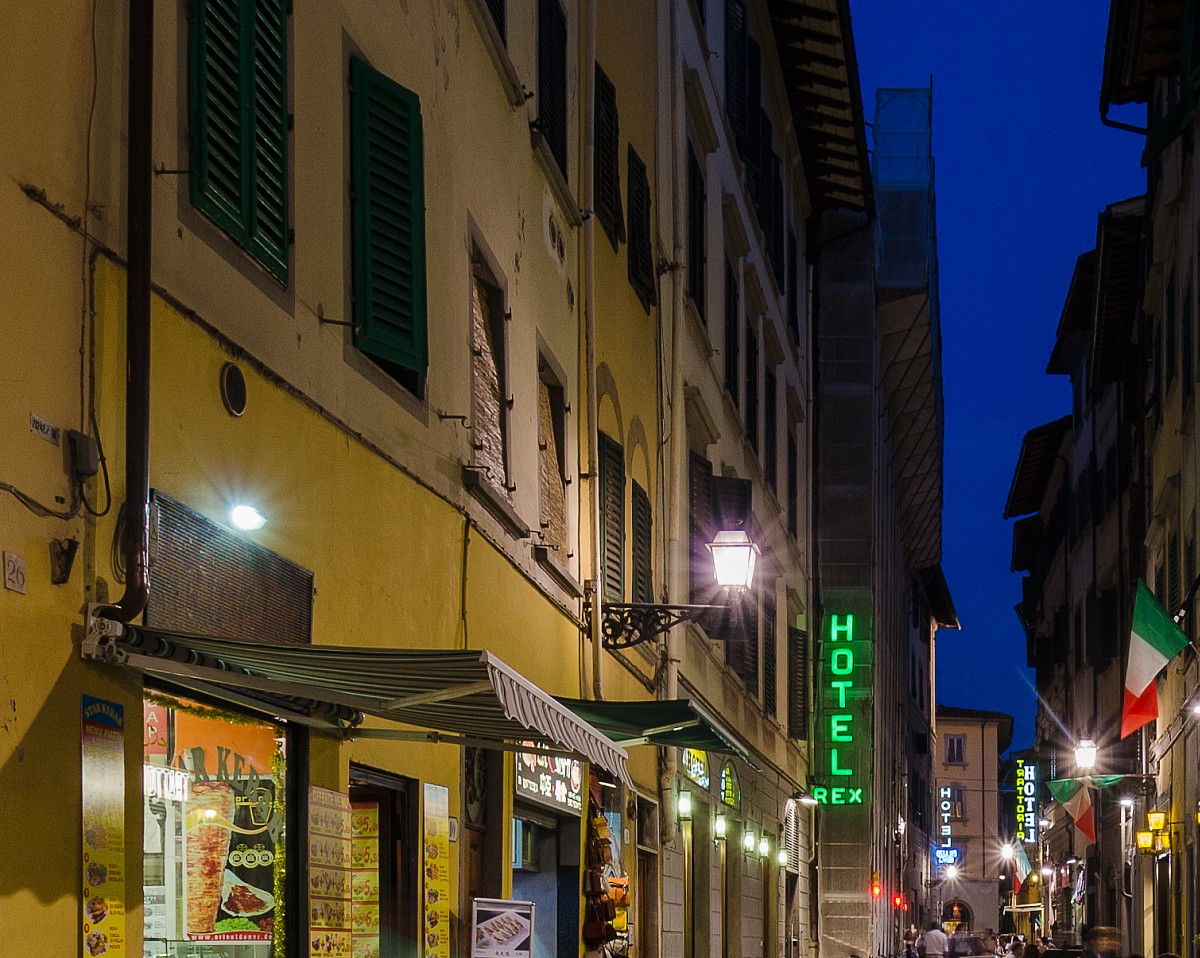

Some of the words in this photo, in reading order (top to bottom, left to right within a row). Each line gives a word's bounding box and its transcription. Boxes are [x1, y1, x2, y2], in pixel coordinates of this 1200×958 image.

[7, 559, 25, 588] 26
[830, 613, 854, 777] HOTEL
[813, 787, 863, 805] REX
